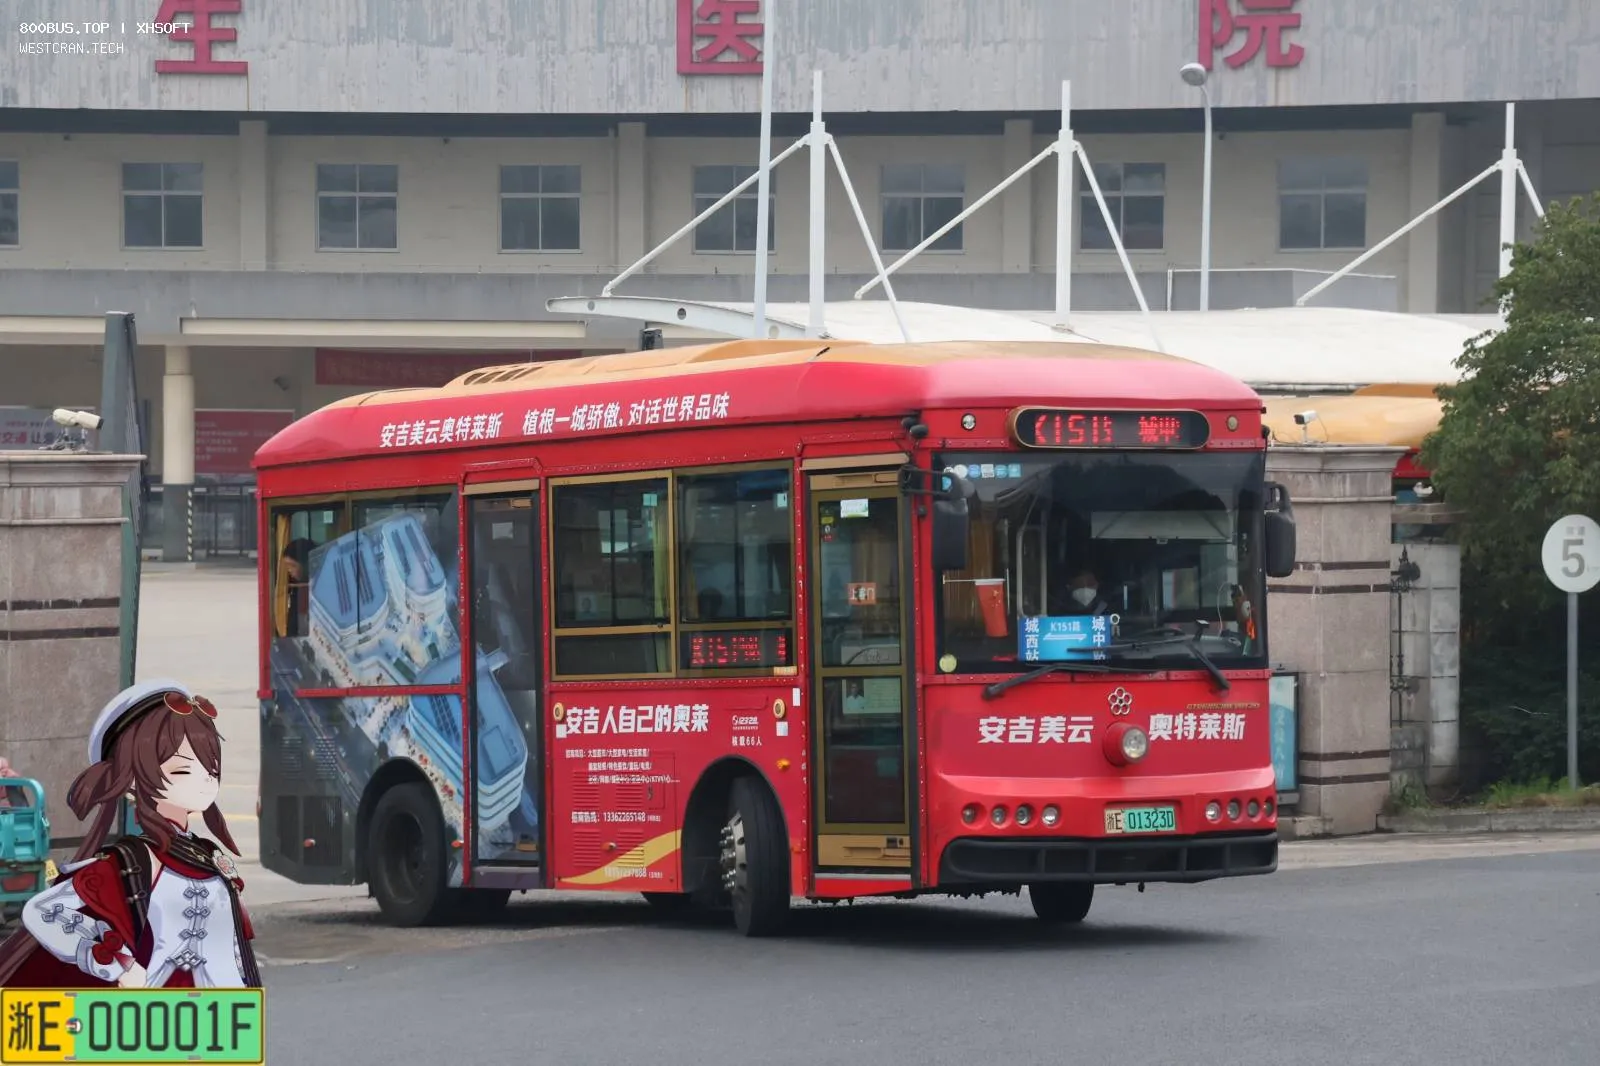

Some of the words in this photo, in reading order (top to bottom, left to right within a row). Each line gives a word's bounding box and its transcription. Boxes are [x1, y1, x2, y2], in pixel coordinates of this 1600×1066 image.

[153, 0, 248, 74] 生
[677, 0, 763, 75] 医
[1198, 0, 1304, 72] 院
[380, 412, 504, 449] 安吉美云奥特莱斯
[1561, 539, 1585, 578] 5
[1025, 617, 1040, 661] 城西站
[1050, 621, 1081, 632] K151路
[566, 703, 710, 735] 安吉人自己的奥莱
[977, 715, 1094, 744] 安吉美云
[1148, 712, 1247, 741] 奥特莱斯
[1128, 809, 1175, 830] 01323D
